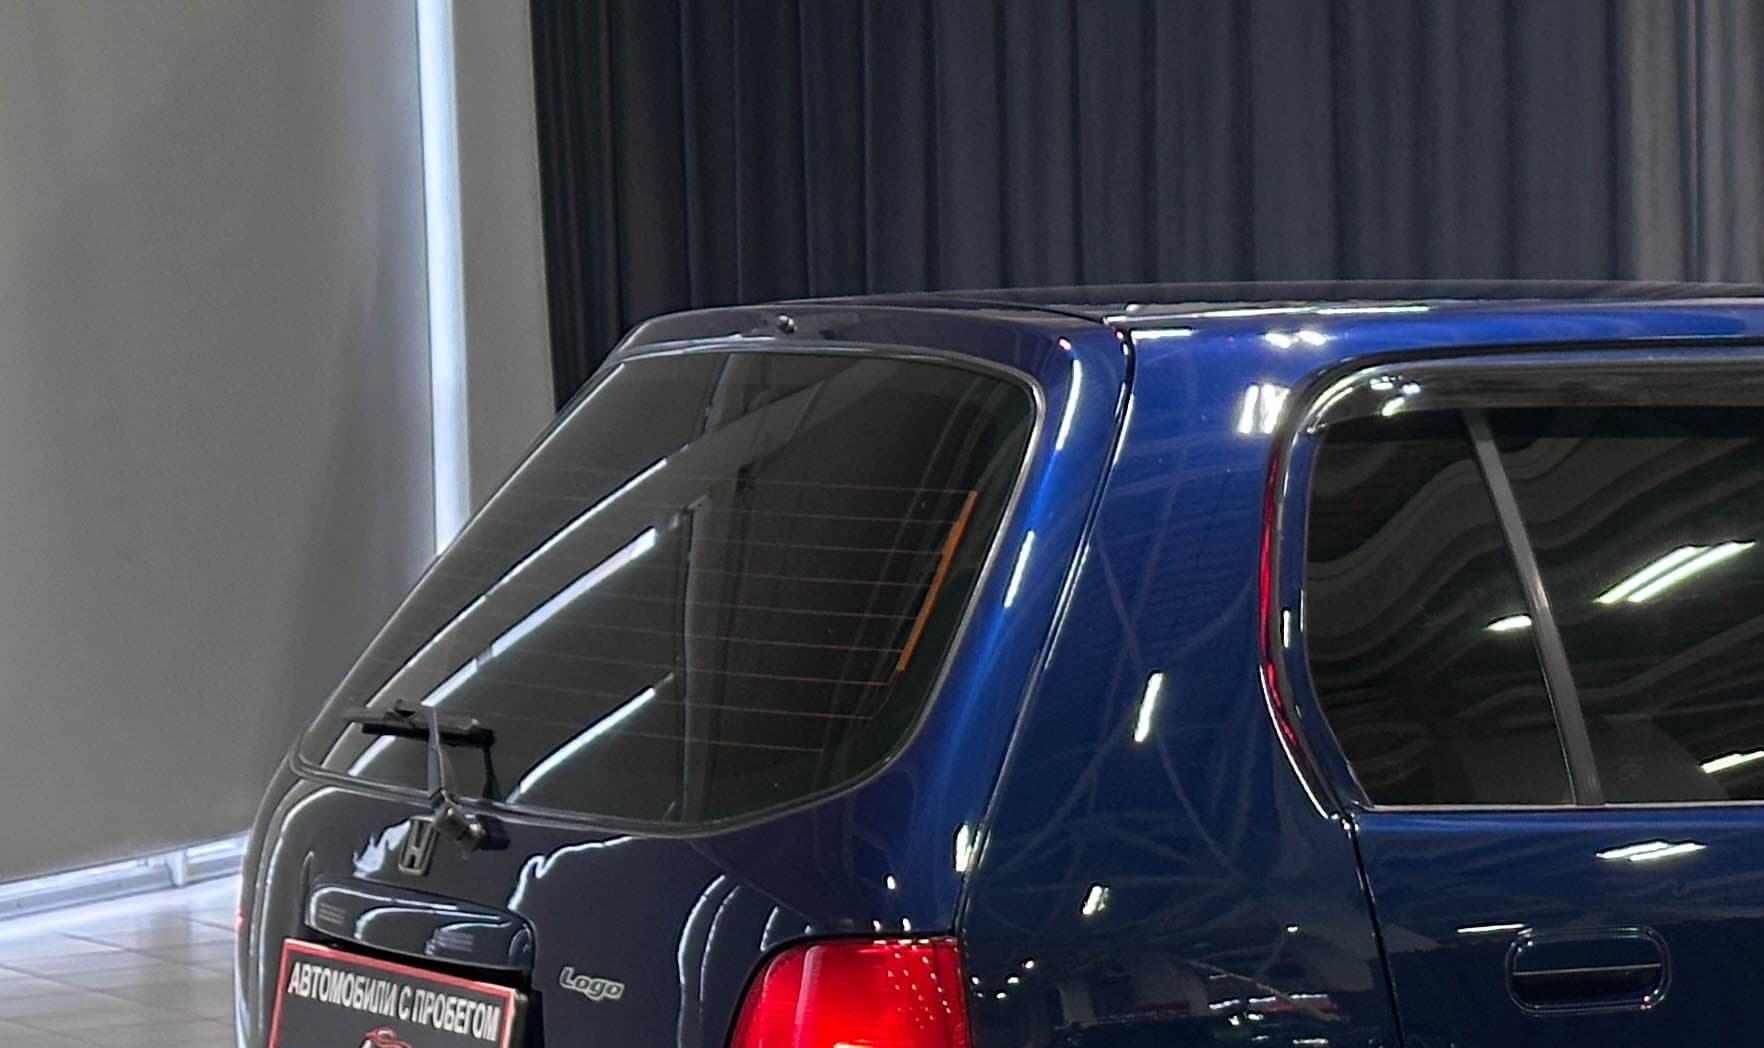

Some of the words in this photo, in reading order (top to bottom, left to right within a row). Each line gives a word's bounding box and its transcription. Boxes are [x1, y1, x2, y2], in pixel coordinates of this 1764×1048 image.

[287, 961, 396, 1017] АВТОМОБИЛИ
[398, 985, 412, 1021] С
[412, 989, 500, 1042] ПРОБЕГОМ
[559, 966, 625, 1001] Logo
